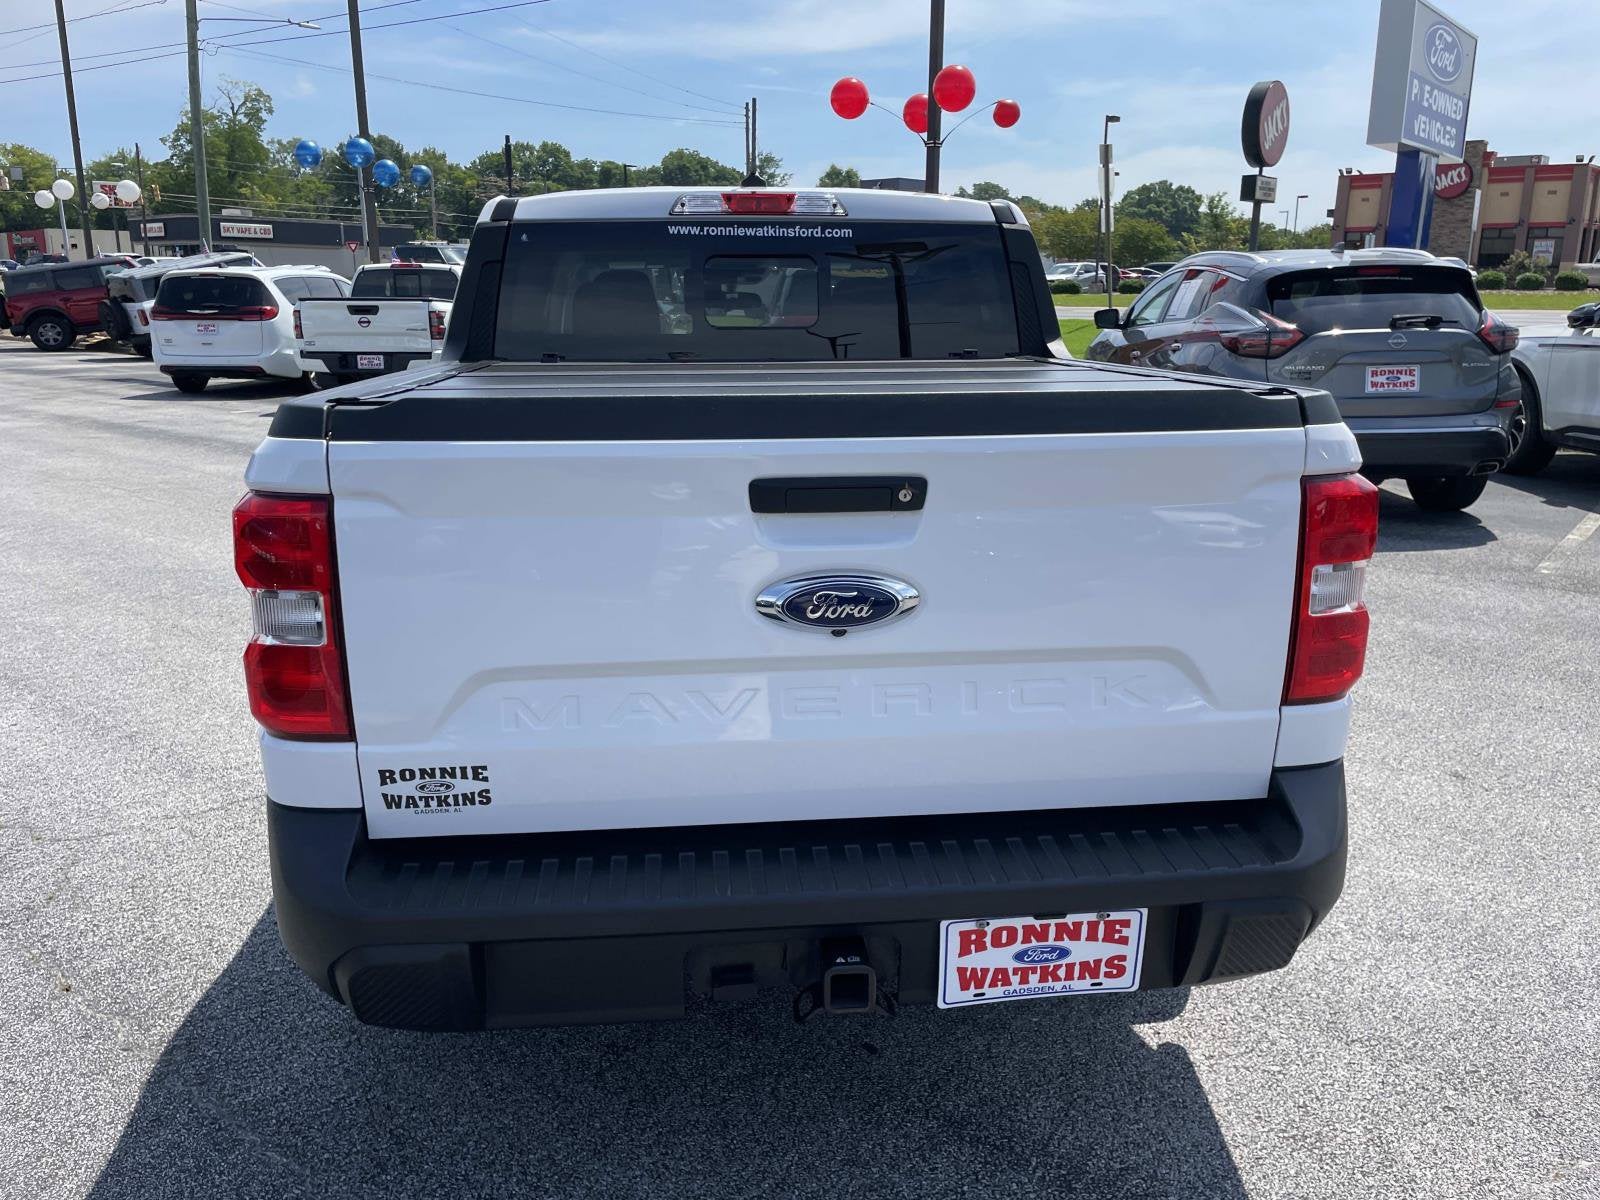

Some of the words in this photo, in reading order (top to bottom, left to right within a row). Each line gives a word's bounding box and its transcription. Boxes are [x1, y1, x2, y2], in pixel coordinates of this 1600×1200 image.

[1430, 29, 1456, 73] Ford
[223, 226, 235, 234] SKY
[236, 227, 252, 235] VAPE
[259, 227, 272, 236] CBD
[667, 224, 853, 239] www.ronniewatkinsford.com
[1370, 368, 1416, 378] RONNIE
[1370, 379, 1416, 390] WATKINS
[806, 591, 874, 619] Ford
[500, 674, 1153, 734] MAVERICK
[378, 765, 489, 787] RONNIE
[423, 783, 448, 793] Ford
[381, 788, 492, 810] WATKINS
[957, 918, 1132, 958] RONNIE
[1023, 947, 1060, 962] Ford
[956, 954, 1128, 992] WATKINS
[1003, 985, 1058, 996] GADSDEN,
[1060, 983, 1075, 992] AL
